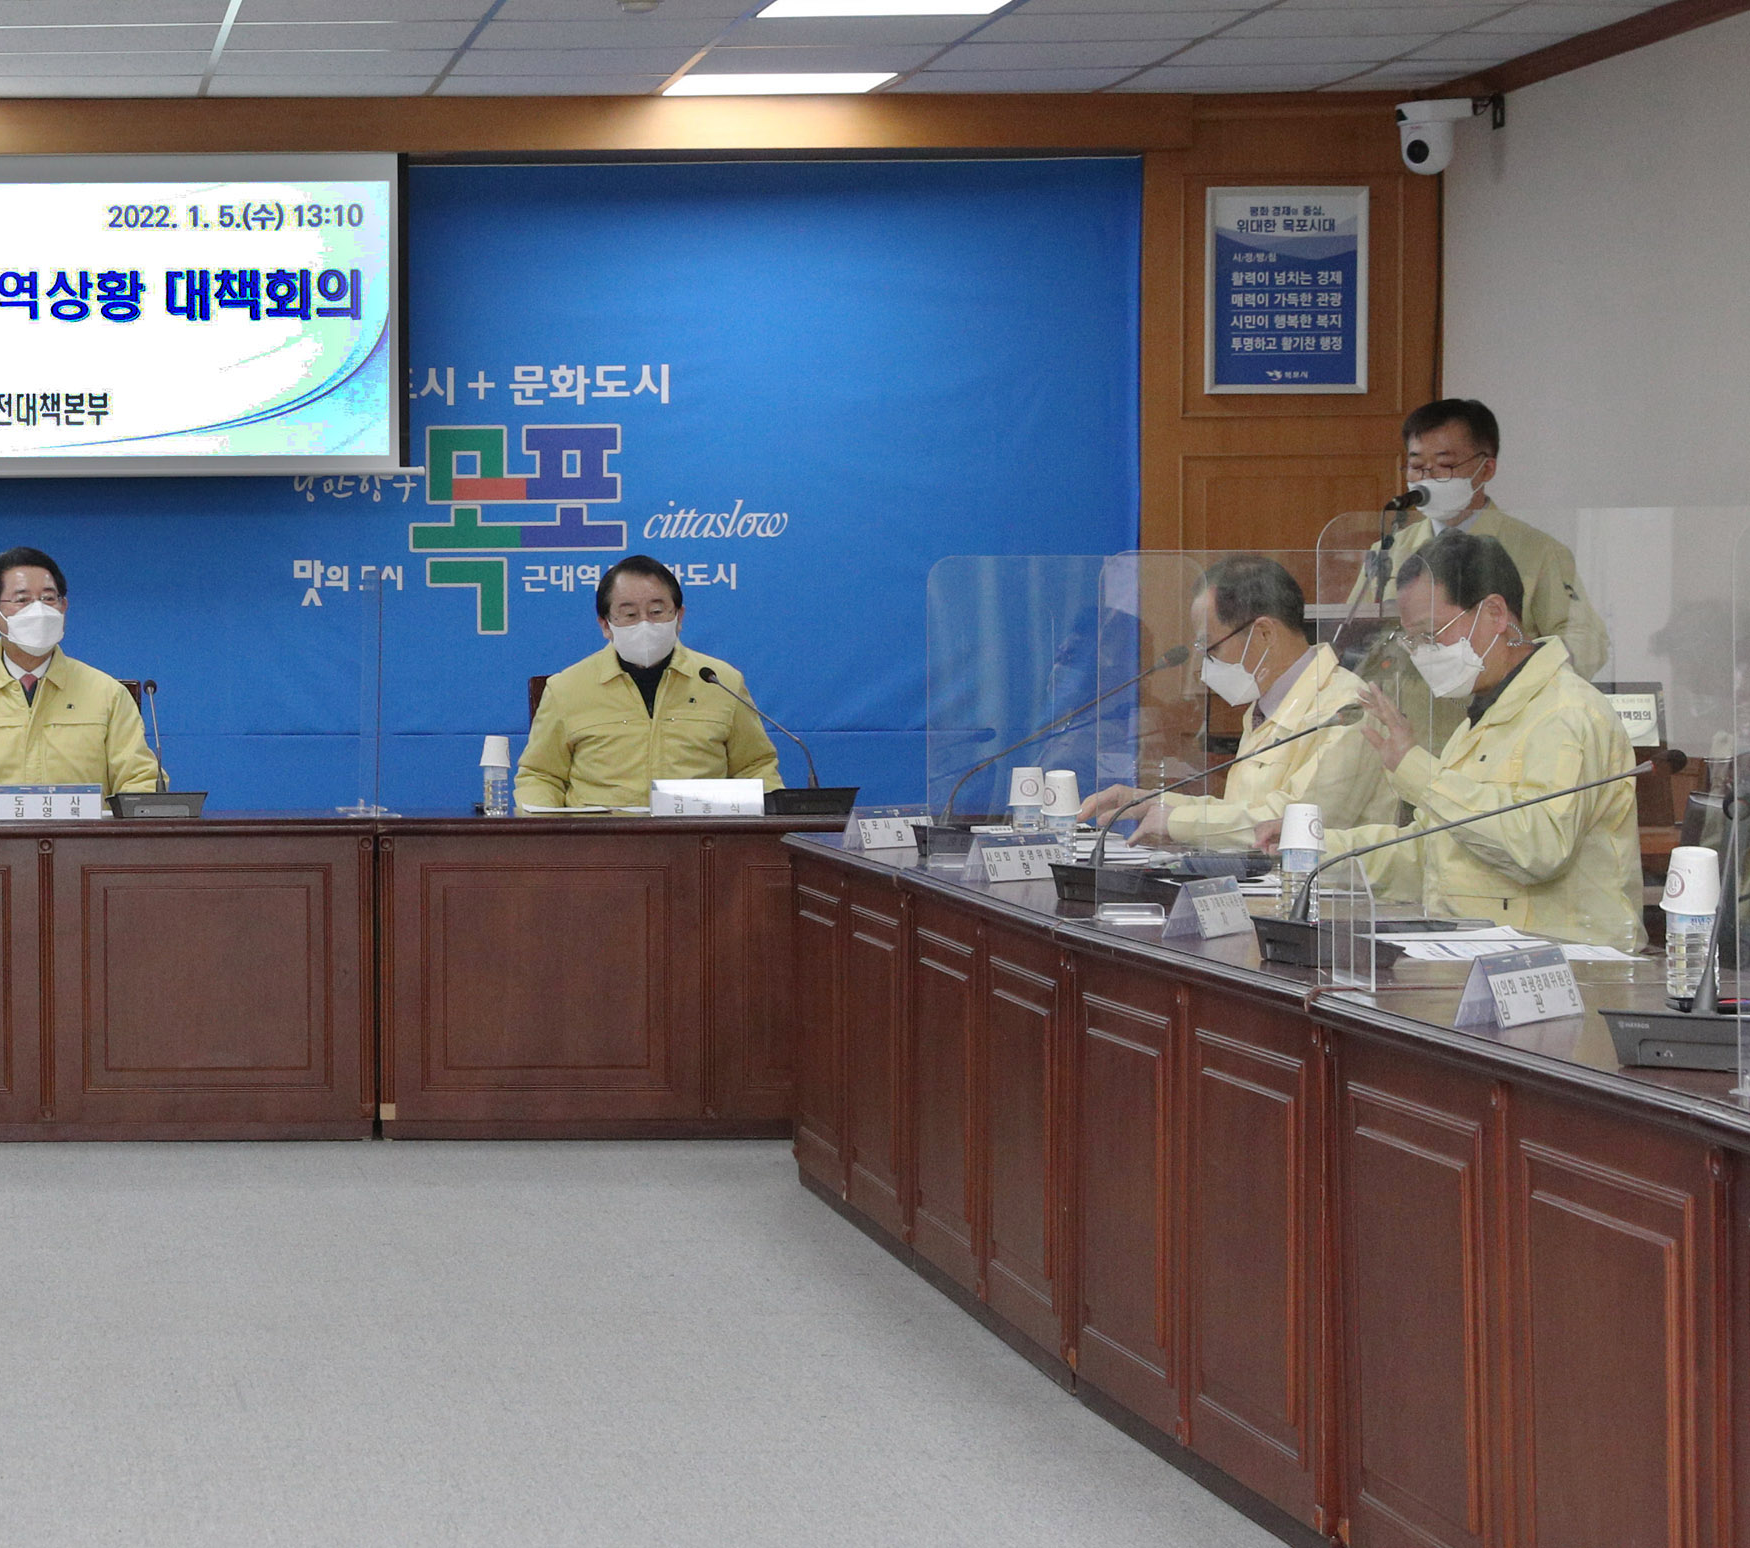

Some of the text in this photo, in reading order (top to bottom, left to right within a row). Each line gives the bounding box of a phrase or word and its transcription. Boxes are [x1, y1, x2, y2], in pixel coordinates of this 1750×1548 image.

[108, 202, 364, 231] 2022. 1. 5.(수) 13:10
[1237, 218, 1335, 233] 위대한 목포시대
[1231, 270, 1343, 286] 활력이 넘치는 경제
[165, 268, 363, 321] 대책회의
[1231, 292, 1343, 308] 매력이 가득한 관광
[1230, 314, 1342, 329] 시민이 행복한 복지
[1231, 337, 1278, 351] 투명하고
[1319, 336, 1343, 351] 행정
[409, 367, 455, 405] 시
[508, 364, 670, 406] 문화도시
[643, 499, 789, 539] cittaslow
[293, 559, 349, 607] 맛의
